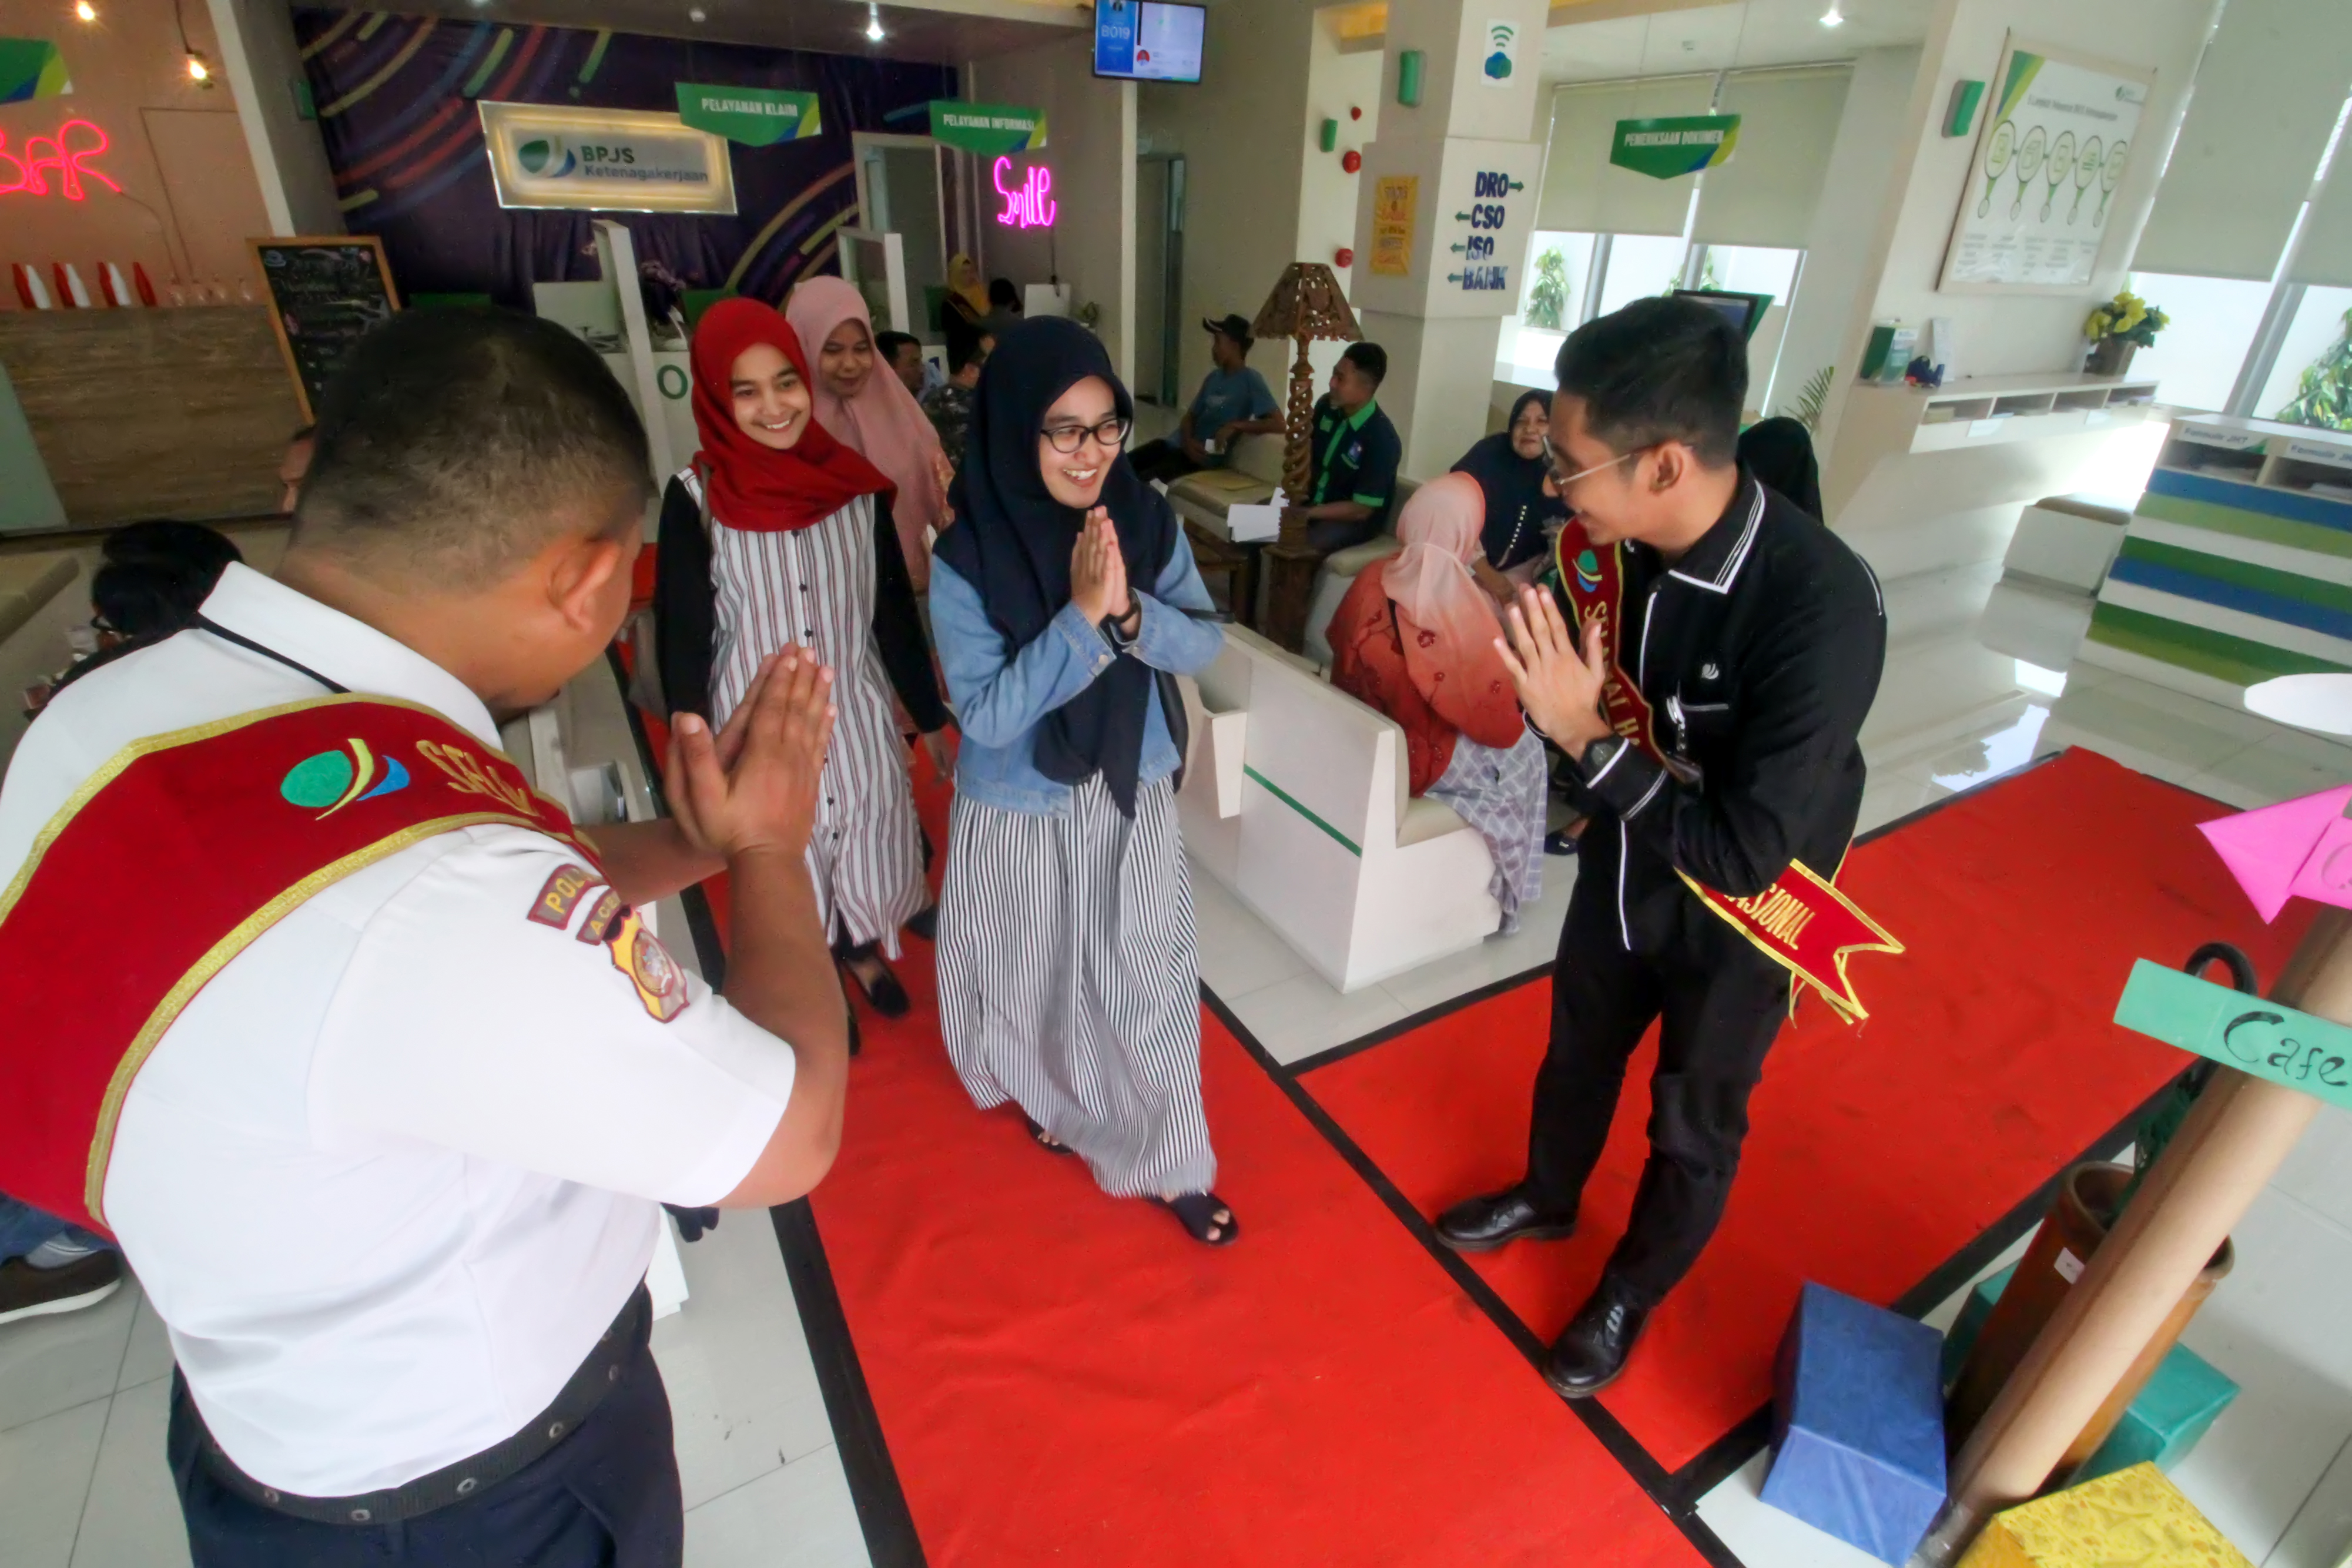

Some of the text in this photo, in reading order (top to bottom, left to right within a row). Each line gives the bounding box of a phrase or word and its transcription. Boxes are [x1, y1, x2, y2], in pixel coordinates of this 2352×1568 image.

[702, 98, 798, 116] PELAYANAN KLAIM
[943, 114, 1034, 132] PELAYANAN INFORMASI
[581, 145, 635, 164] BPJS
[585, 165, 708, 182] Ketenagakerjaan
[1475, 171, 1509, 198] DRO
[1471, 203, 1505, 229] CSO
[1466, 236, 1494, 260] ISO
[1462, 266, 1508, 290] BANK
[2223, 1011, 2349, 1087] Cafe
